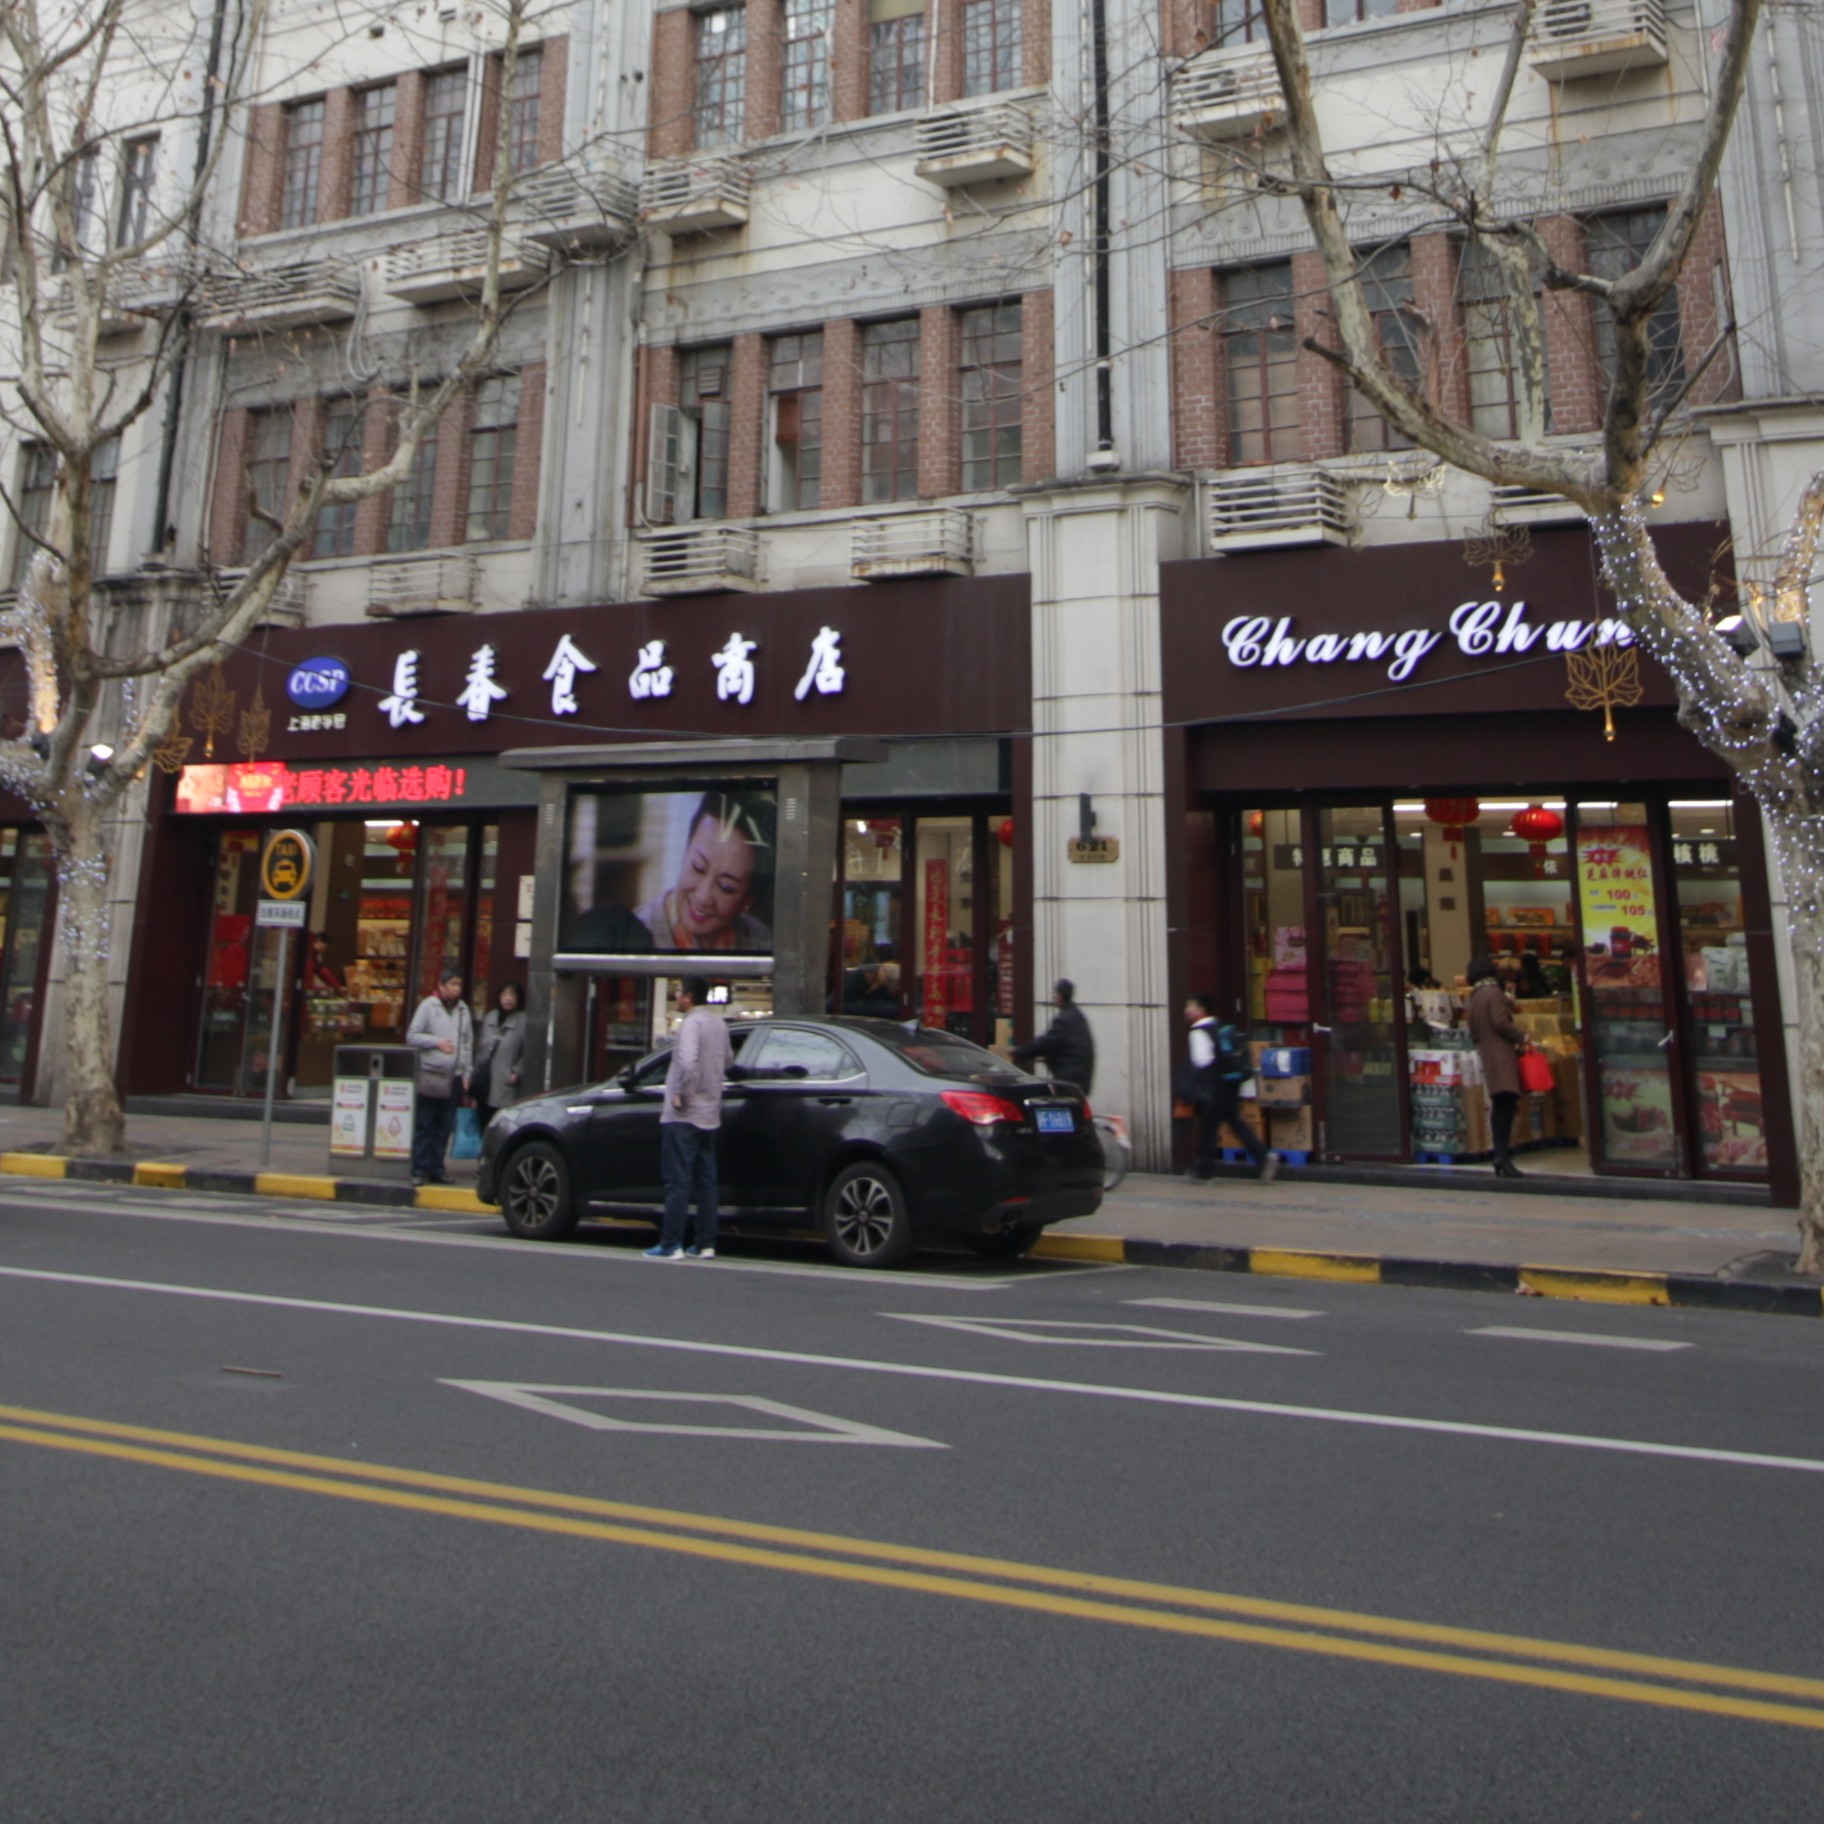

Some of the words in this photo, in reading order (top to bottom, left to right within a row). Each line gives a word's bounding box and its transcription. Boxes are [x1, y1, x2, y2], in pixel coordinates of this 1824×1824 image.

[1220, 614, 1442, 682] Chang
[290, 668, 346, 694] CCSP
[1673, 843, 1720, 865] 核桃
[1607, 888, 1631, 901] 100
[1622, 904, 1646, 917] 105
